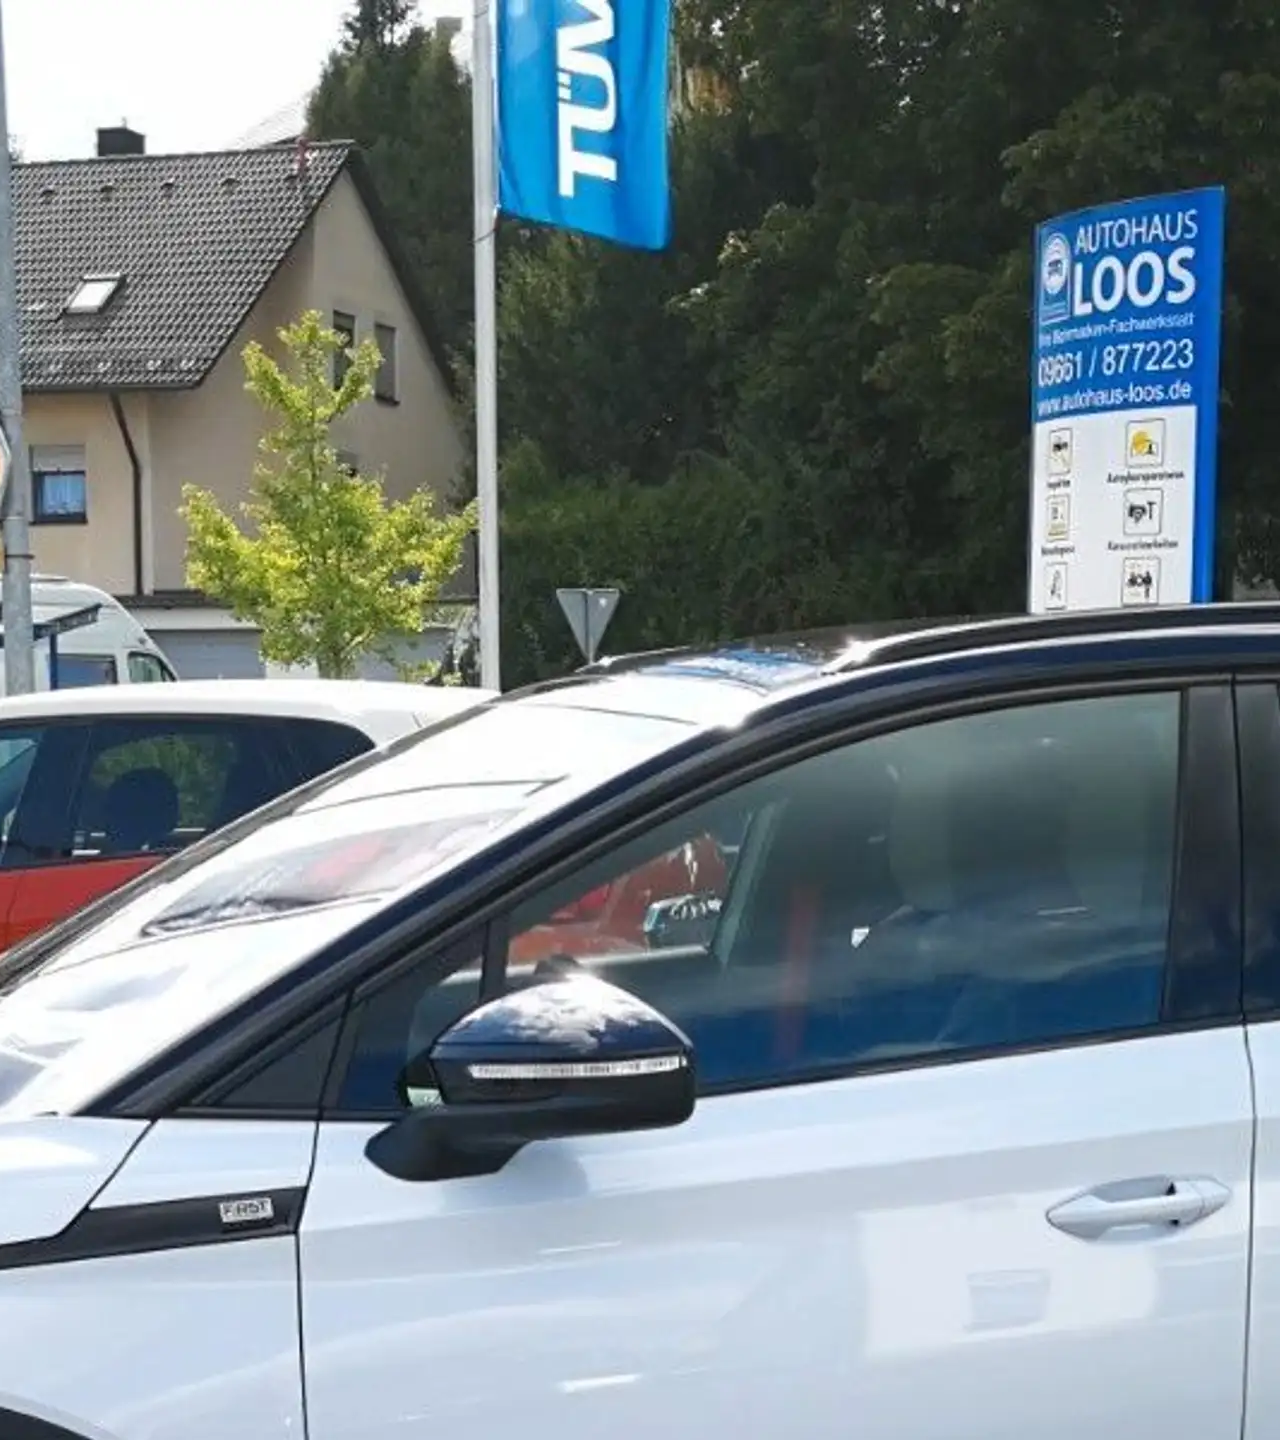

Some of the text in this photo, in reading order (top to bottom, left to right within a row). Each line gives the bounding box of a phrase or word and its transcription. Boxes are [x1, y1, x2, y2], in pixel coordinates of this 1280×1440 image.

[557, 0, 618, 199] TÜV
[1074, 208, 1199, 255] AUTOHAUS
[1073, 245, 1196, 316] LOOS
[1038, 351, 1083, 387] 09661
[1102, 338, 1194, 377] 877223
[1038, 379, 1193, 416] www.autohaus-loos.de
